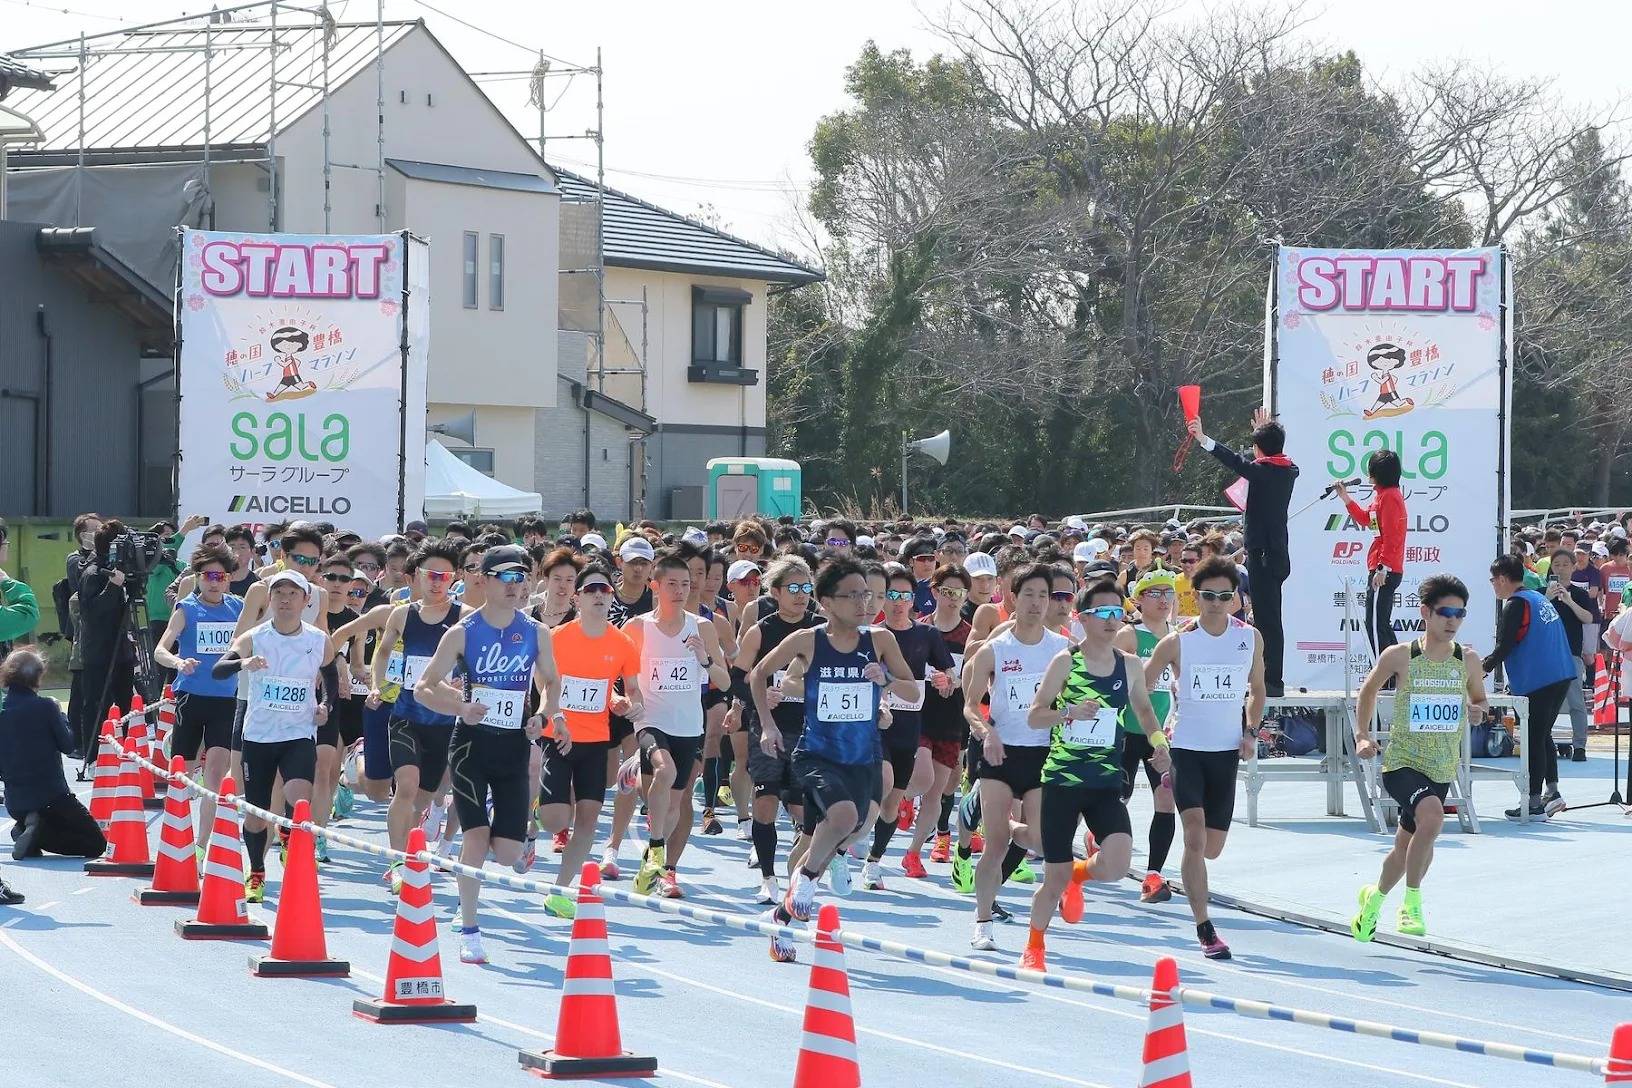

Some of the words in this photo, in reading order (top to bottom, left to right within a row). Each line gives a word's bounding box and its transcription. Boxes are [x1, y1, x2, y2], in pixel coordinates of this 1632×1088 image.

[201, 242, 387, 298] START
[1298, 256, 1486, 312] START
[224, 343, 262, 367] 穂の国
[312, 327, 343, 352] 豊橋
[241, 362, 273, 383] ハーフ
[308, 347, 357, 371] マラソン
[1322, 361, 1359, 384] 穂の国
[1409, 344, 1440, 367] 豊橋
[1339, 380, 1369, 400] ハーフ
[1406, 363, 1455, 386] マラソン
[230, 466, 350, 484] サーラグループ
[245, 495, 351, 514] AICELLO
[198, 631, 206, 644] A
[388, 659, 396, 672] A
[475, 642, 530, 674] ilex
[406, 665, 413, 679] A
[477, 674, 507, 683] SPORTS
[651, 667, 659, 680] A
[670, 666, 688, 681] 42
[1193, 674, 1201, 689] A
[1214, 674, 1232, 690] 14
[264, 684, 271, 698] A
[275, 686, 306, 702] 1288
[561, 685, 569, 699] A
[581, 687, 599, 702] 17
[1010, 685, 1018, 700] A
[496, 700, 514, 717] 18
[820, 693, 828, 709] A
[841, 693, 858, 710] 51
[1412, 704, 1420, 720] A
[1424, 704, 1459, 721] 1008
[484, 716, 515, 727] AICELLO
[1090, 718, 1100, 733] 7
[1075, 736, 1106, 744] AICELLO
[400, 980, 440, 995] 豊橋市
